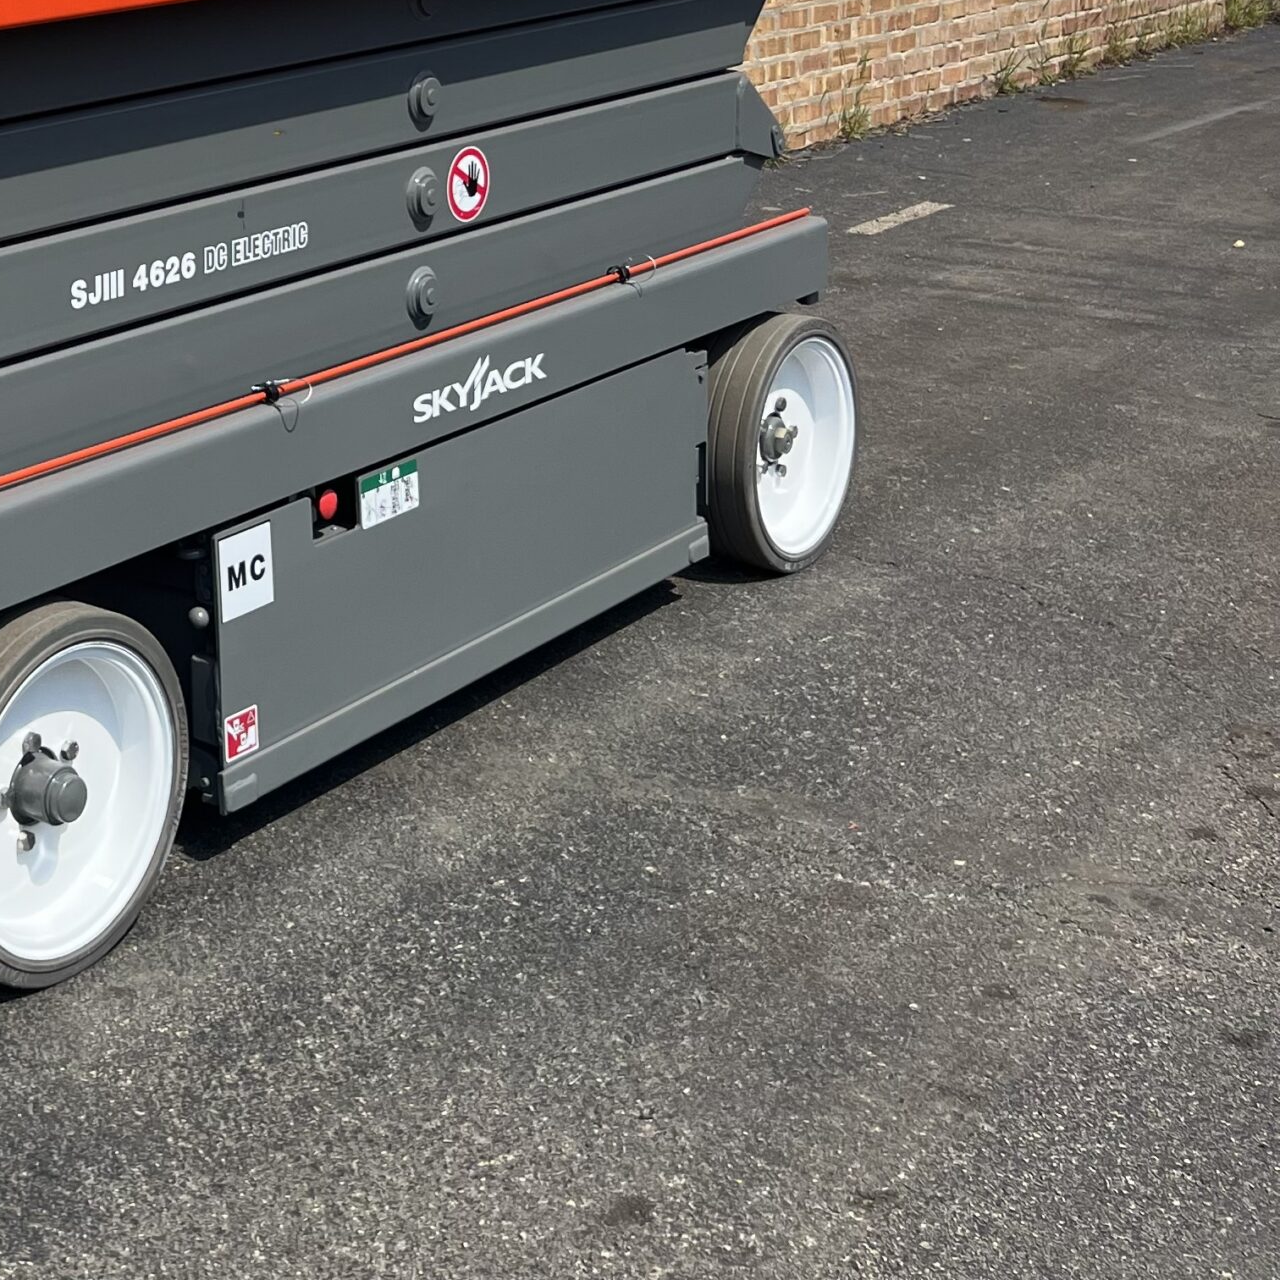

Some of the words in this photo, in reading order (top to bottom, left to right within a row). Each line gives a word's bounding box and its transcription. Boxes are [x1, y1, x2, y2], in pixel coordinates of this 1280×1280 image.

[71, 269, 124, 309] SJIII
[133, 252, 196, 291] 4626
[204, 243, 227, 274] DC
[232, 222, 308, 267] ELECTRIC
[413, 353, 547, 423] SKYJACK
[227, 554, 266, 591] MC
